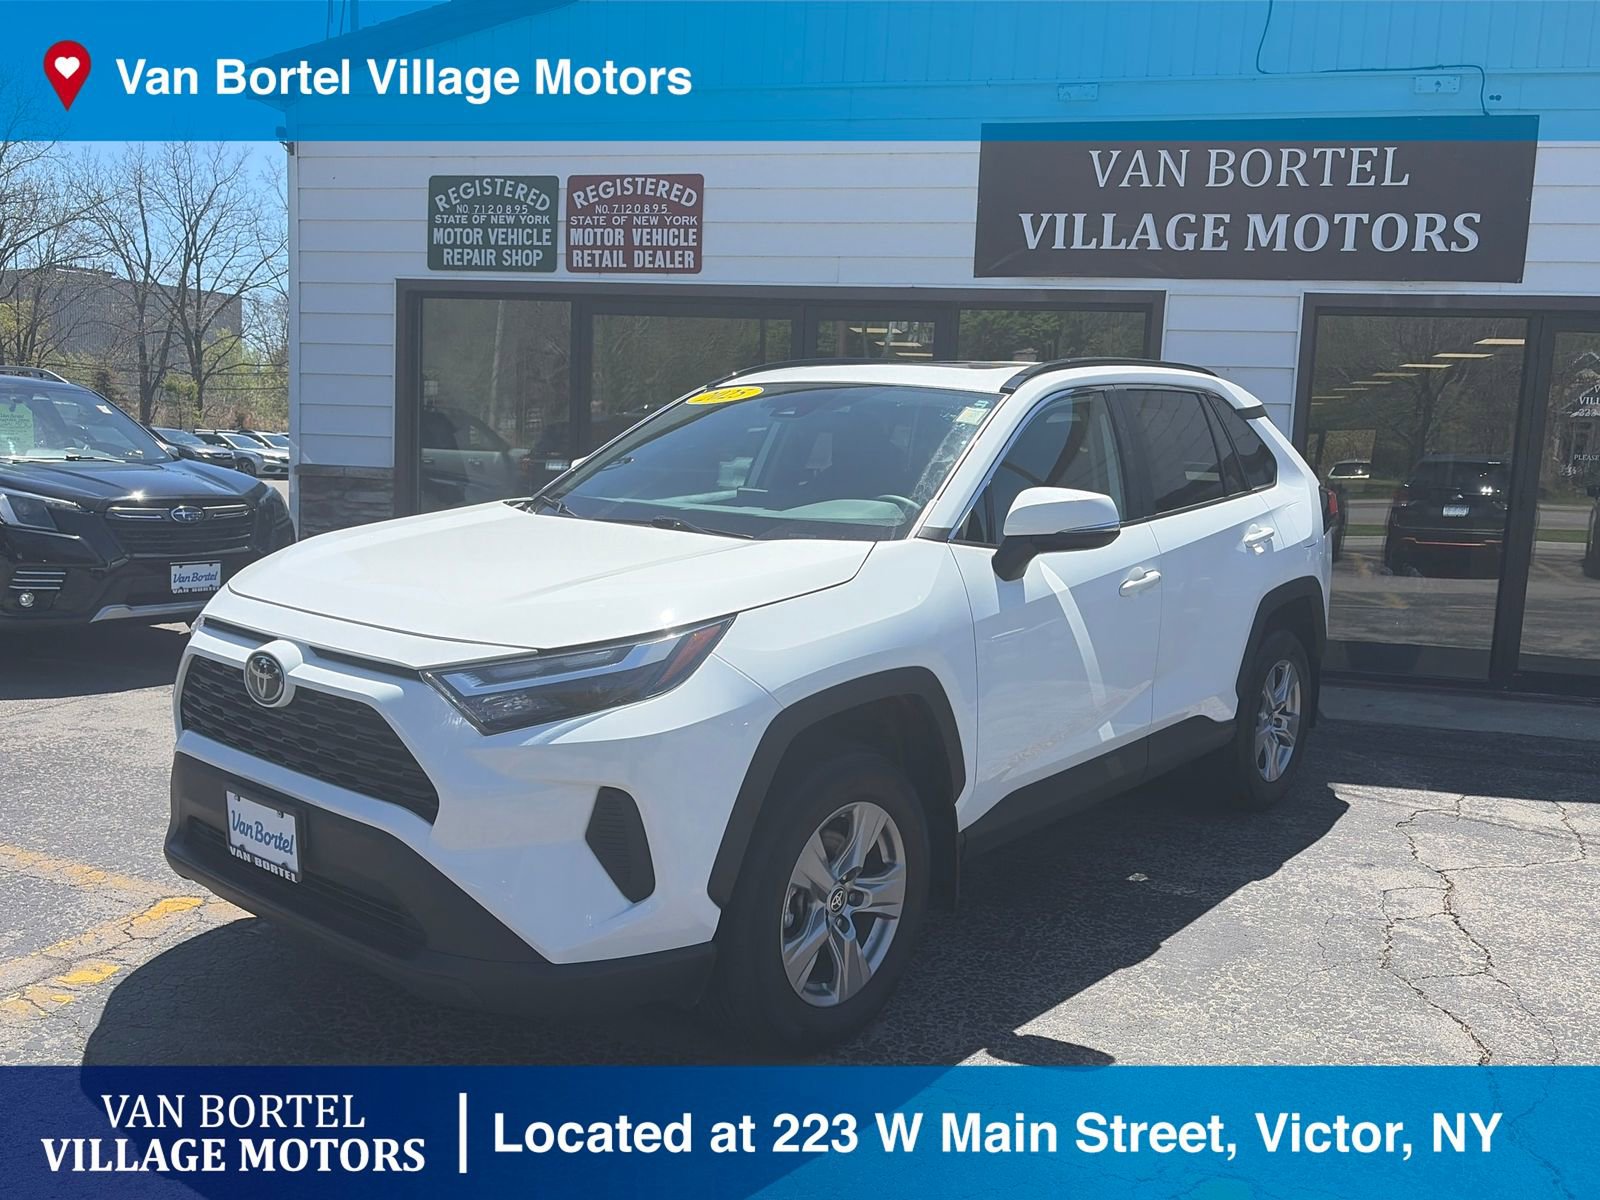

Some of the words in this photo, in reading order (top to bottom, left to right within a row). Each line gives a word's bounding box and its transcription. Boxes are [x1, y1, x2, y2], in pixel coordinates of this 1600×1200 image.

[1088, 149, 1191, 188] VAN
[1204, 146, 1410, 188] BORTEL
[435, 178, 550, 211] REGISTERED
[572, 177, 698, 209] REGISTERED
[473, 204, 528, 214] 7120895
[595, 204, 610, 214] NO.
[612, 203, 668, 214] 7120895
[434, 215, 468, 224] STATE
[472, 215, 487, 224] OF
[491, 215, 516, 224] NEW
[520, 215, 550, 224] YORK
[570, 216, 606, 225] STATE
[612, 216, 627, 225] OF
[633, 216, 658, 225] NEW
[664, 216, 698, 225] YORK
[433, 227, 483, 245] MOTOR
[488, 227, 552, 246] VEHICLE
[570, 228, 625, 246] MOTOR
[632, 228, 697, 247] VEHICLE
[1018, 212, 1231, 251] VILLAGE
[1243, 212, 1481, 253] MOTORS
[443, 248, 496, 266] REPAIR
[502, 249, 543, 266] SHOP
[572, 250, 627, 267] RETAIL
[633, 250, 695, 268] DEALER
[173, 573, 191, 583] Van
[191, 571, 218, 582] Bortel
[231, 810, 254, 840] Van
[254, 821, 294, 856] Bortel
[229, 846, 252, 863] VAN
[254, 857, 299, 884] BORTEL
